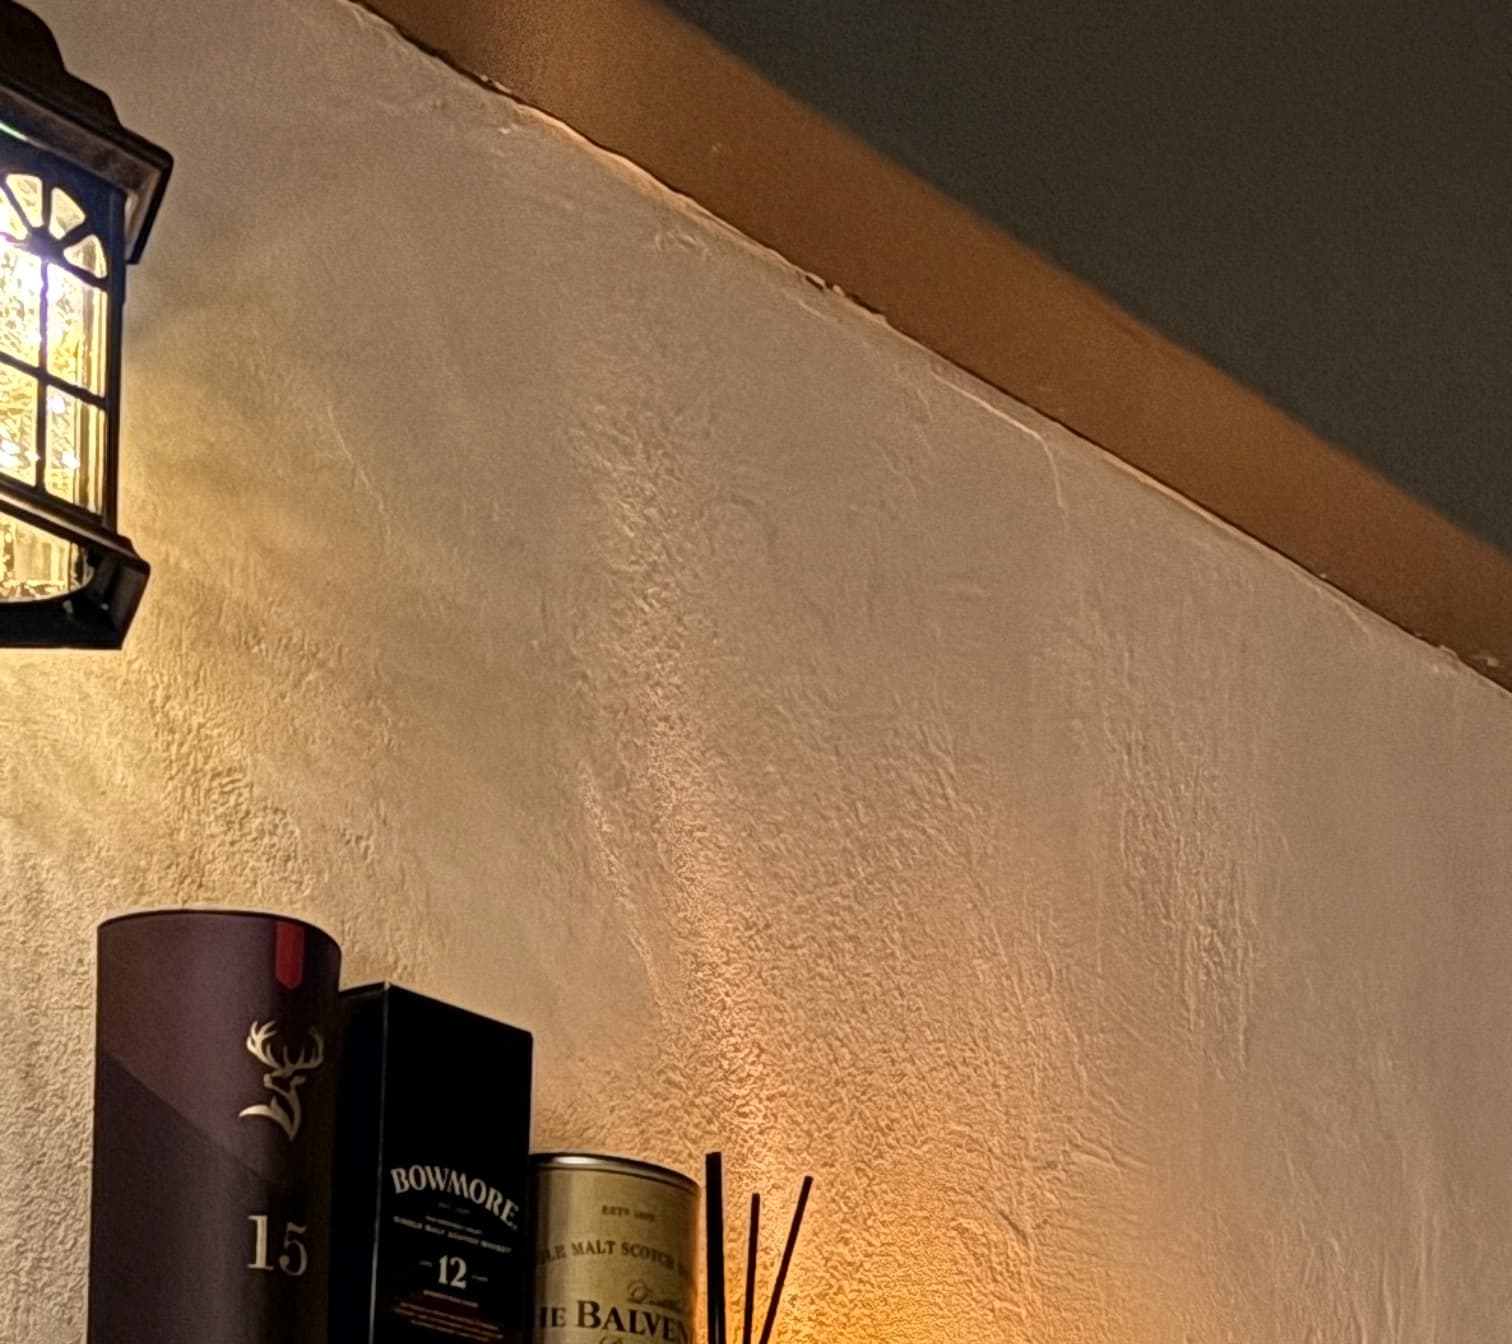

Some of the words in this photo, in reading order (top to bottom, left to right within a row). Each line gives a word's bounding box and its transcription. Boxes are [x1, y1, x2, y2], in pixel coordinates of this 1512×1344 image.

[247, 1214, 308, 1277] 15
[571, 1239, 616, 1257] MALT
[437, 1254, 468, 1290] 12
